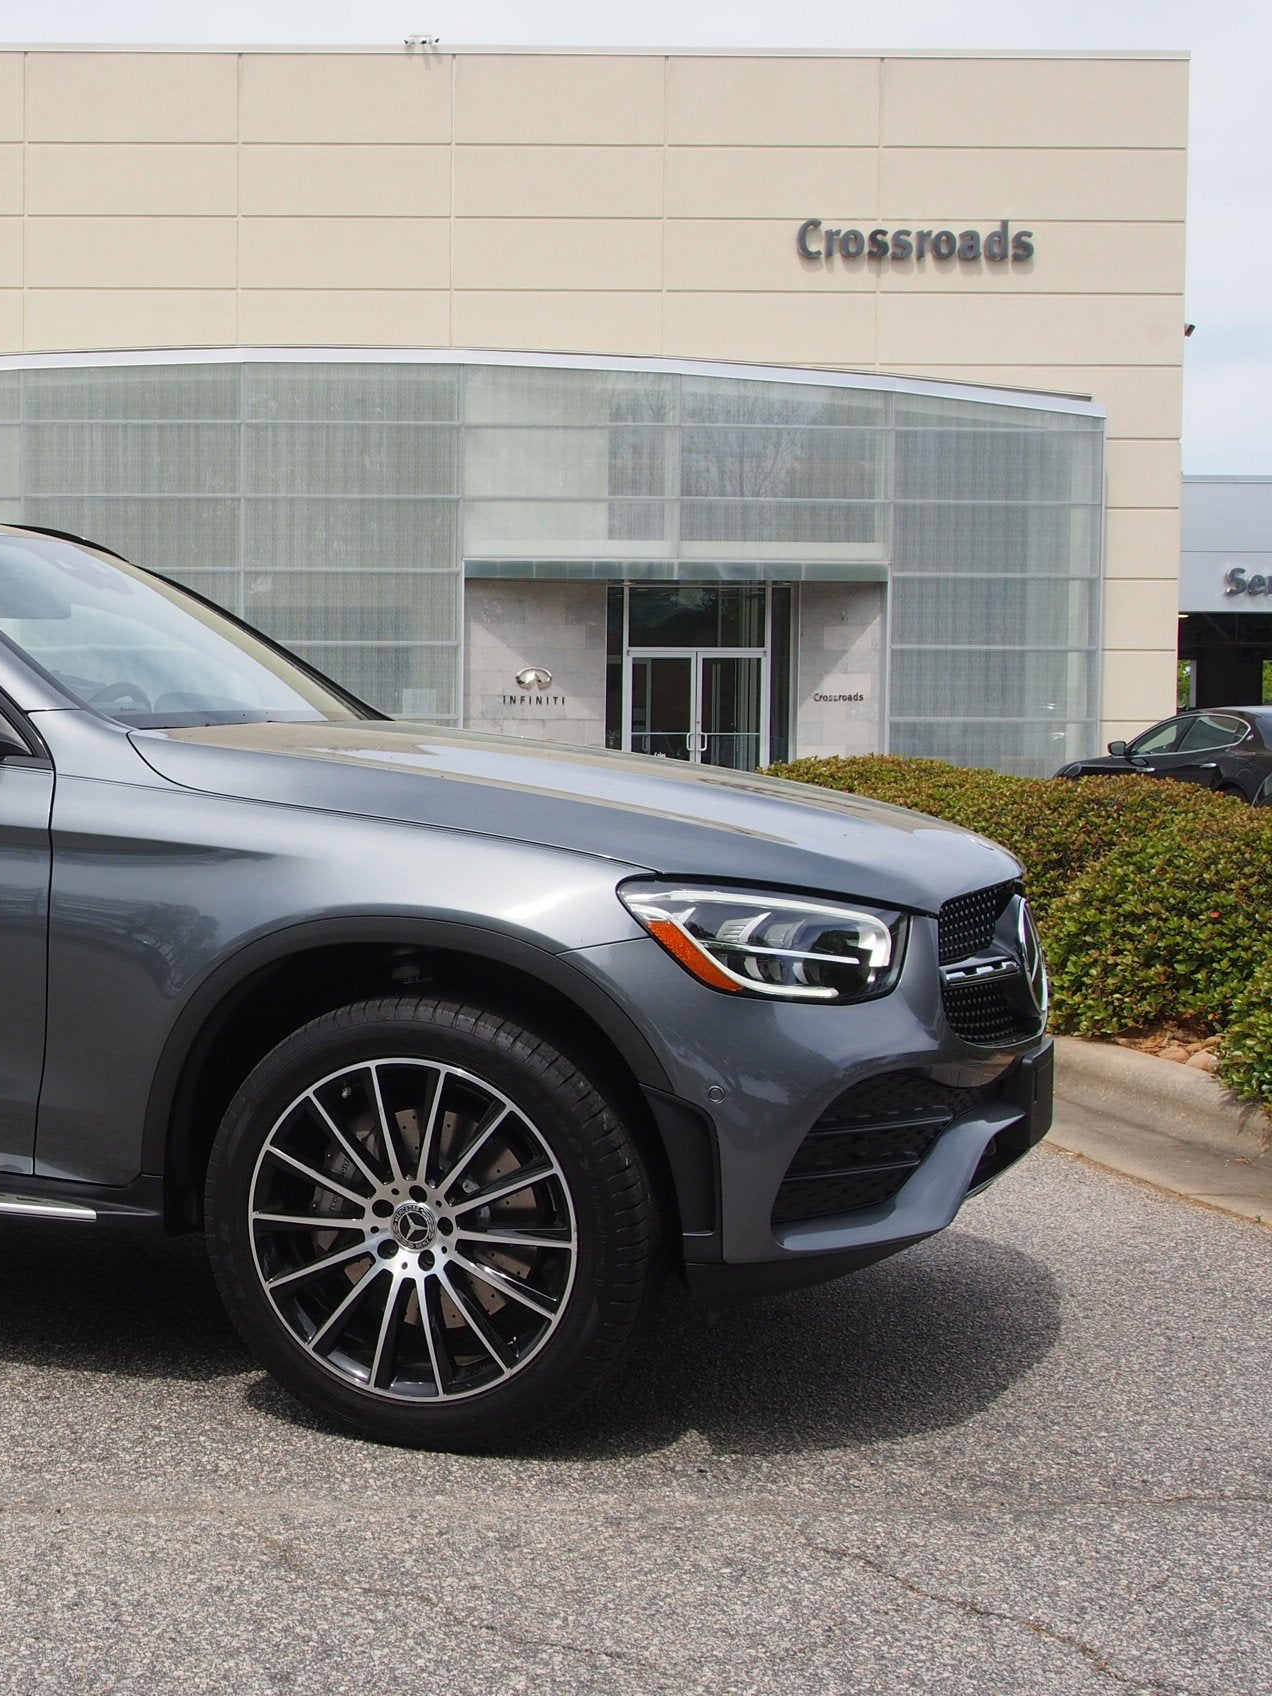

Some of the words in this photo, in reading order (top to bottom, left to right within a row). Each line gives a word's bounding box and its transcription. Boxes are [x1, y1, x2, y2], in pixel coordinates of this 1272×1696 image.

[796, 218, 1035, 261] Crossroads
[502, 695, 565, 705] INFINITI
[813, 692, 864, 702] Crossroads
